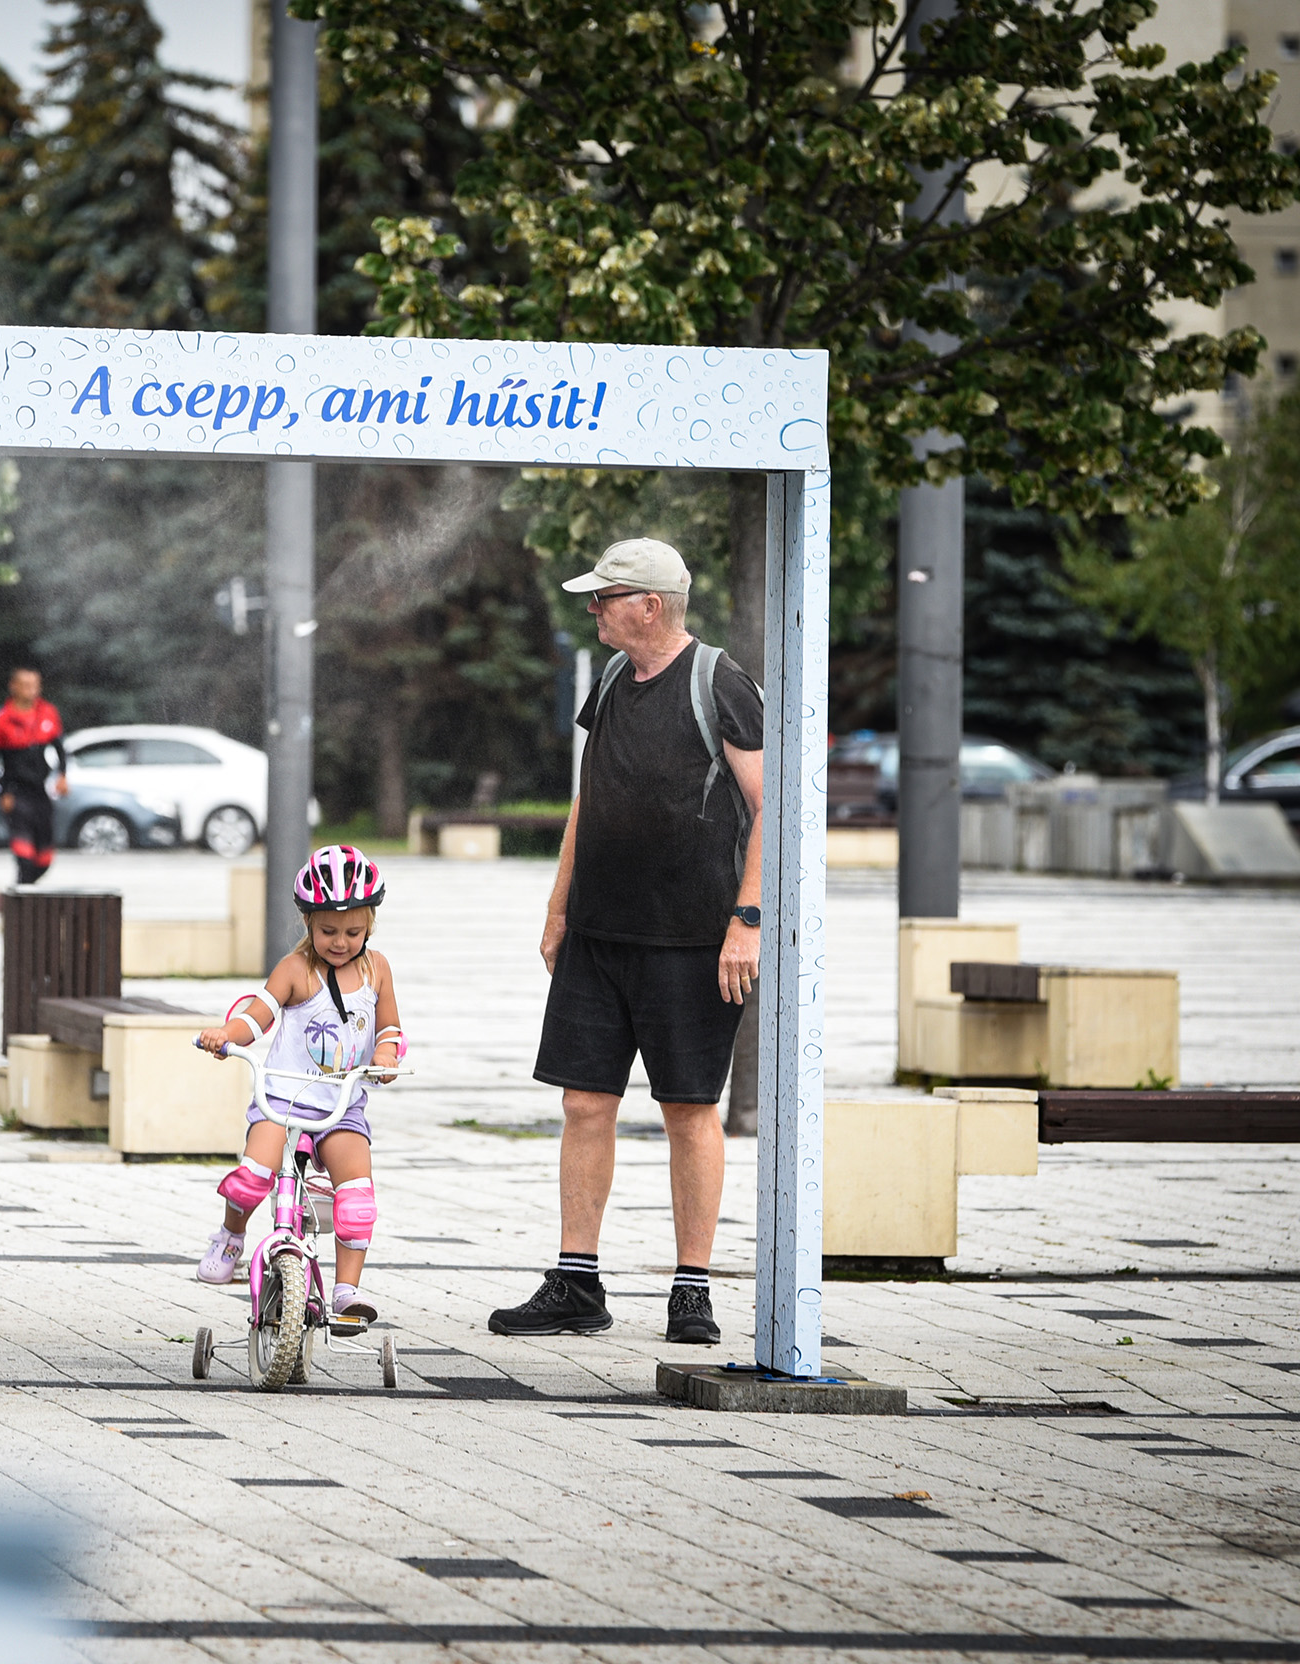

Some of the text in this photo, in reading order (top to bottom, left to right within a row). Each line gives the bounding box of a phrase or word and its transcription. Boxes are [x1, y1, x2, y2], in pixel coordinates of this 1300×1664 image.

[70, 365, 608, 432] A csepp, ami hűsít!
